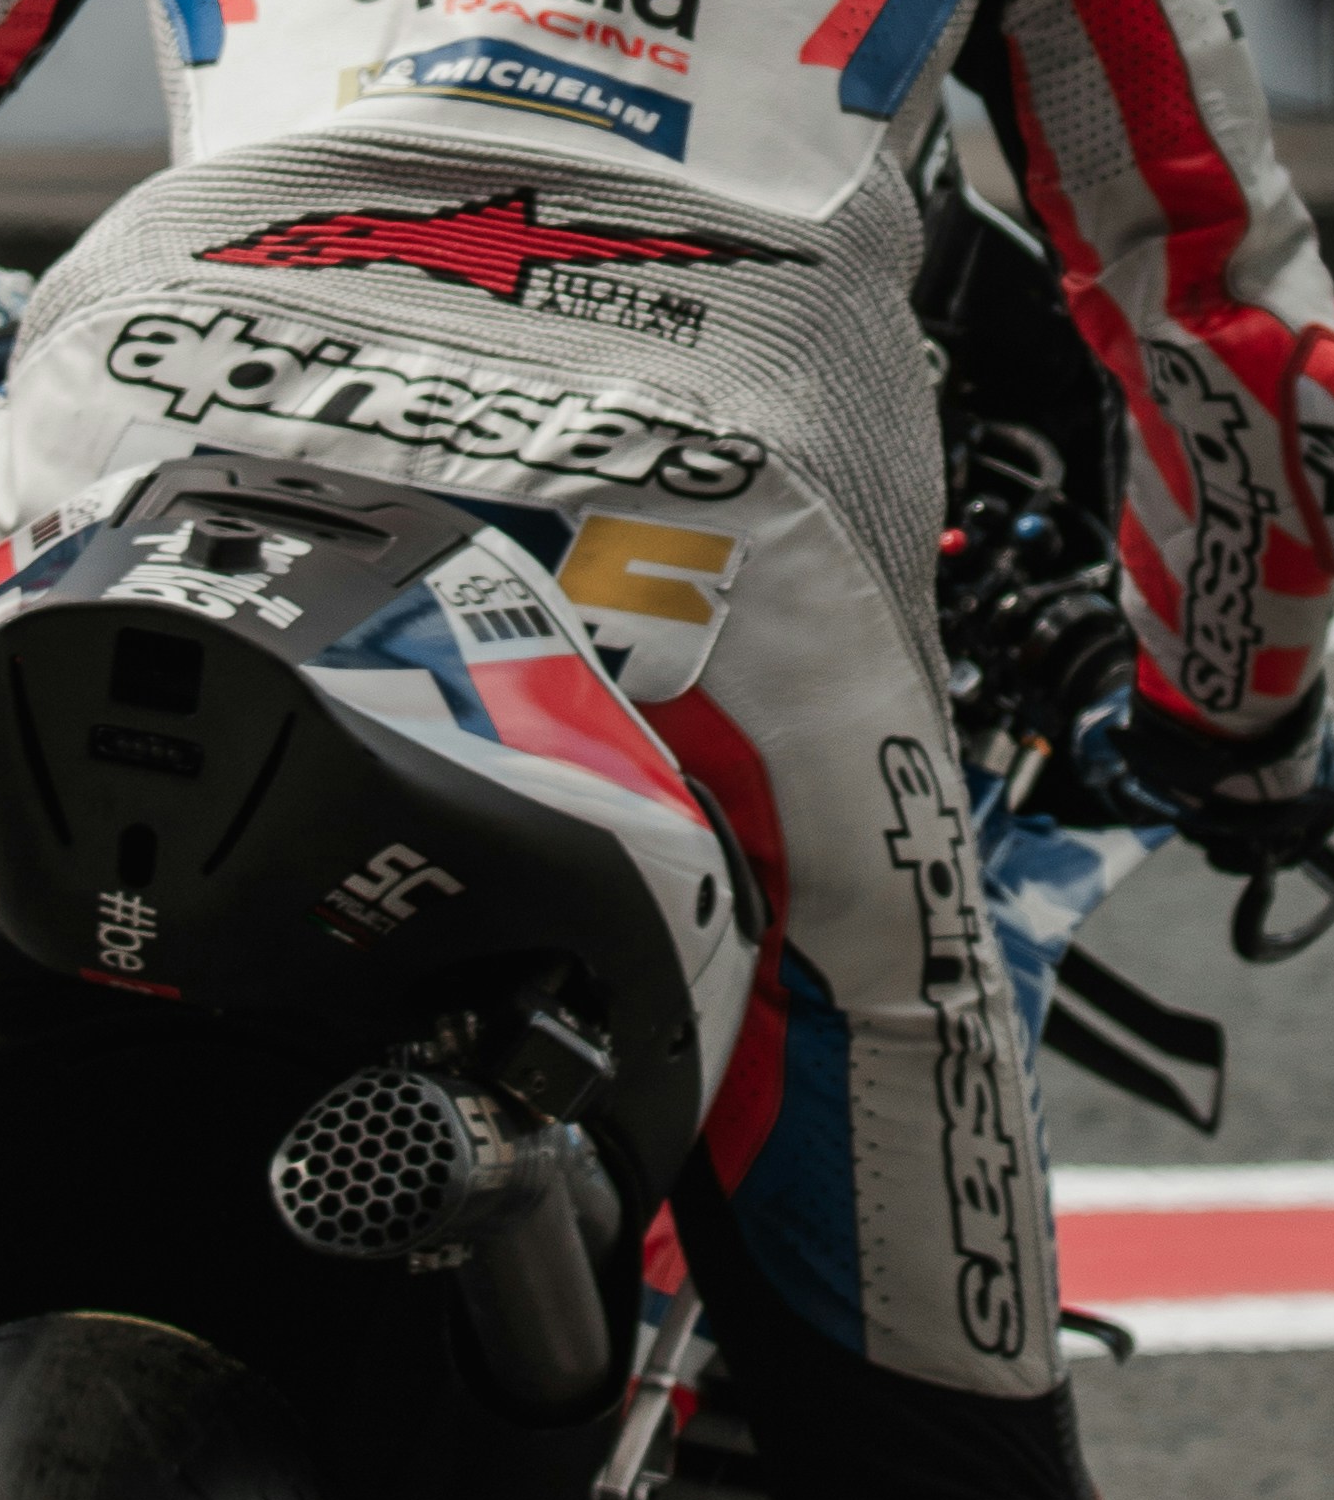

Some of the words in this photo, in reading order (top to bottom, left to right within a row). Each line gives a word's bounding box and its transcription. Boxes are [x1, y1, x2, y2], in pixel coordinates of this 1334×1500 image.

[424, 54, 662, 135] MICHELIN
[107, 309, 768, 500] alpinestars
[433, 574, 531, 609] GoPro
[341, 841, 468, 921] SC
[96, 889, 159, 973] #be
[878, 734, 1026, 1360] alpinestars
